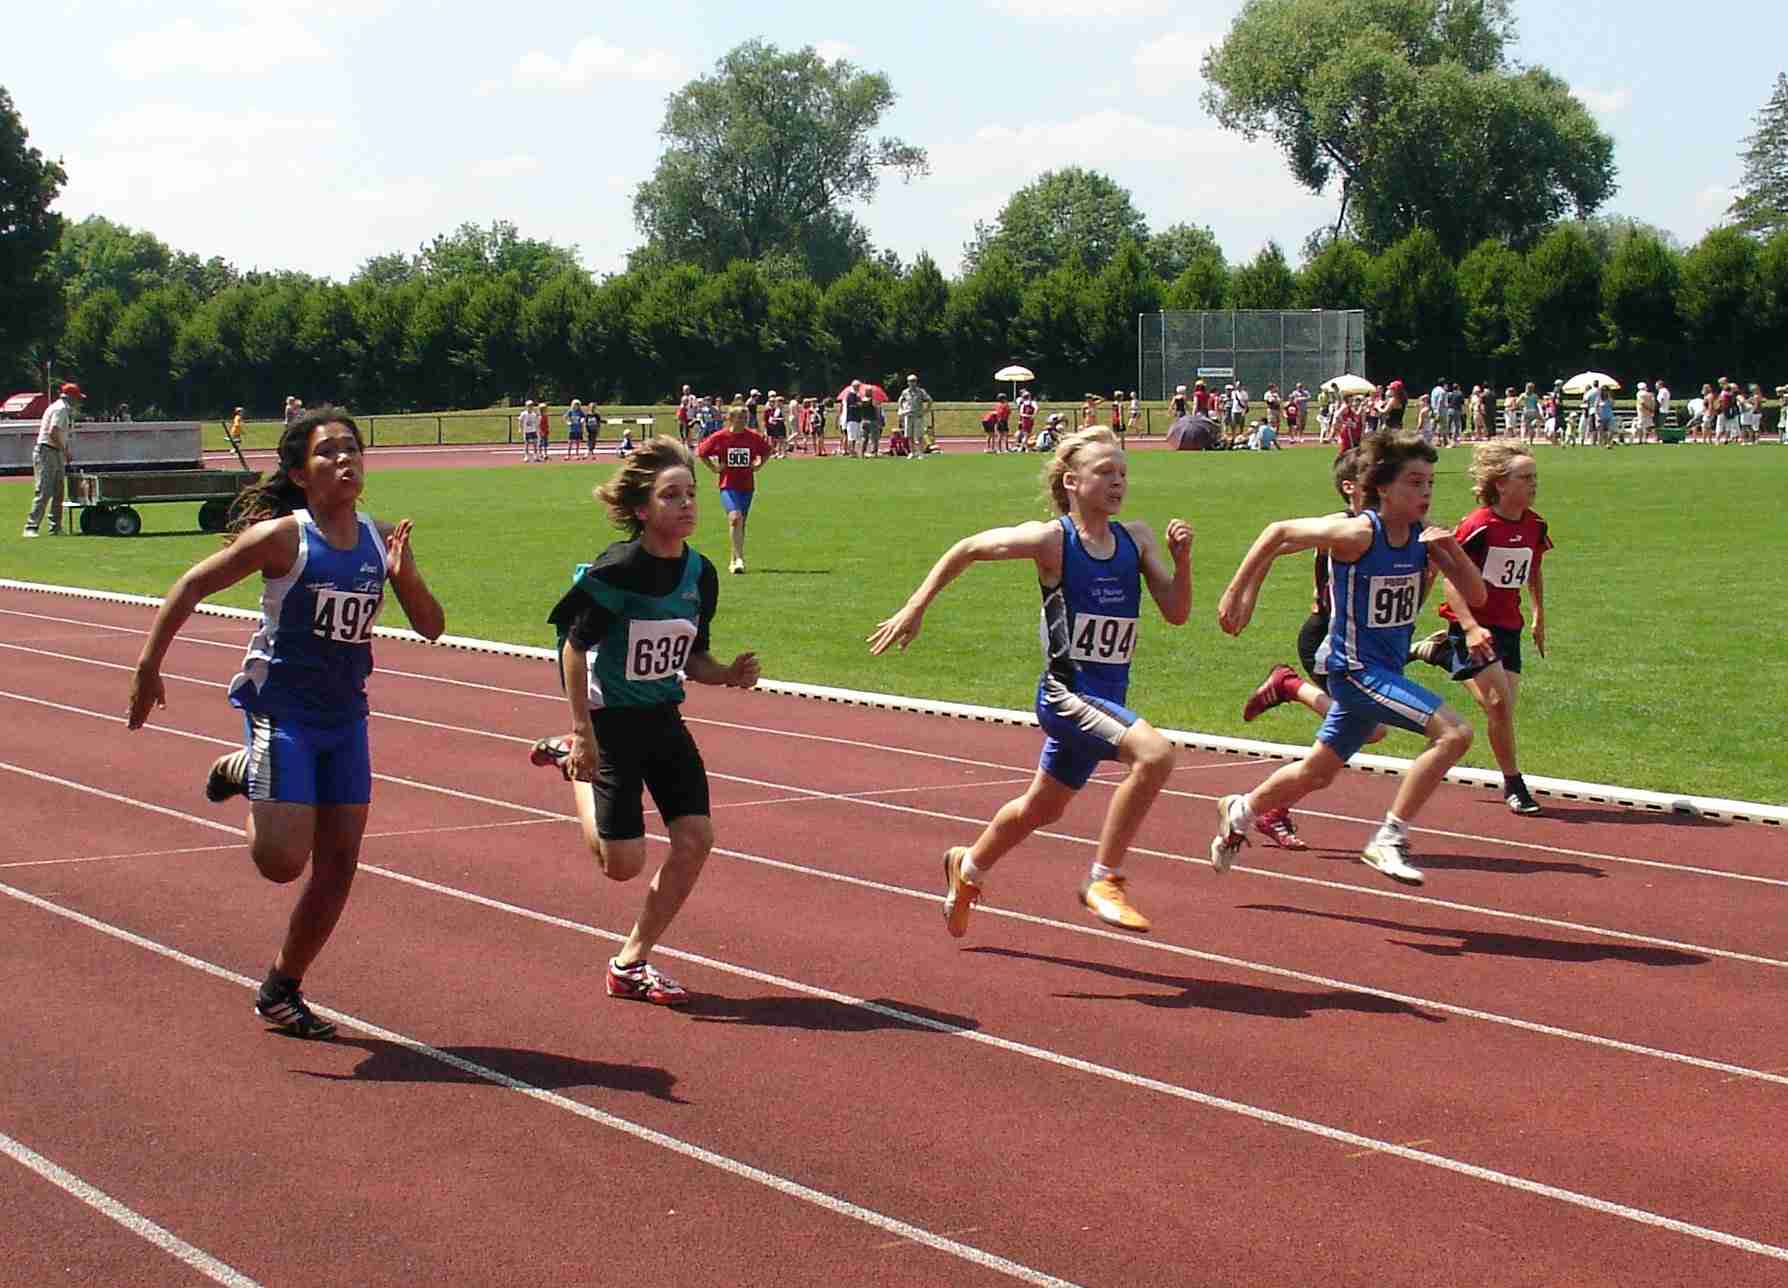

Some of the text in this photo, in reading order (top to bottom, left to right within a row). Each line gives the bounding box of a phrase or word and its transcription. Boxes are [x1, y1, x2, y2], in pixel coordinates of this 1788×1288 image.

[1501, 559, 1528, 585] 34
[314, 597, 376, 640] 492
[1375, 586, 1414, 625] 918
[634, 635, 689, 676] 639
[1077, 619, 1135, 658] 494
